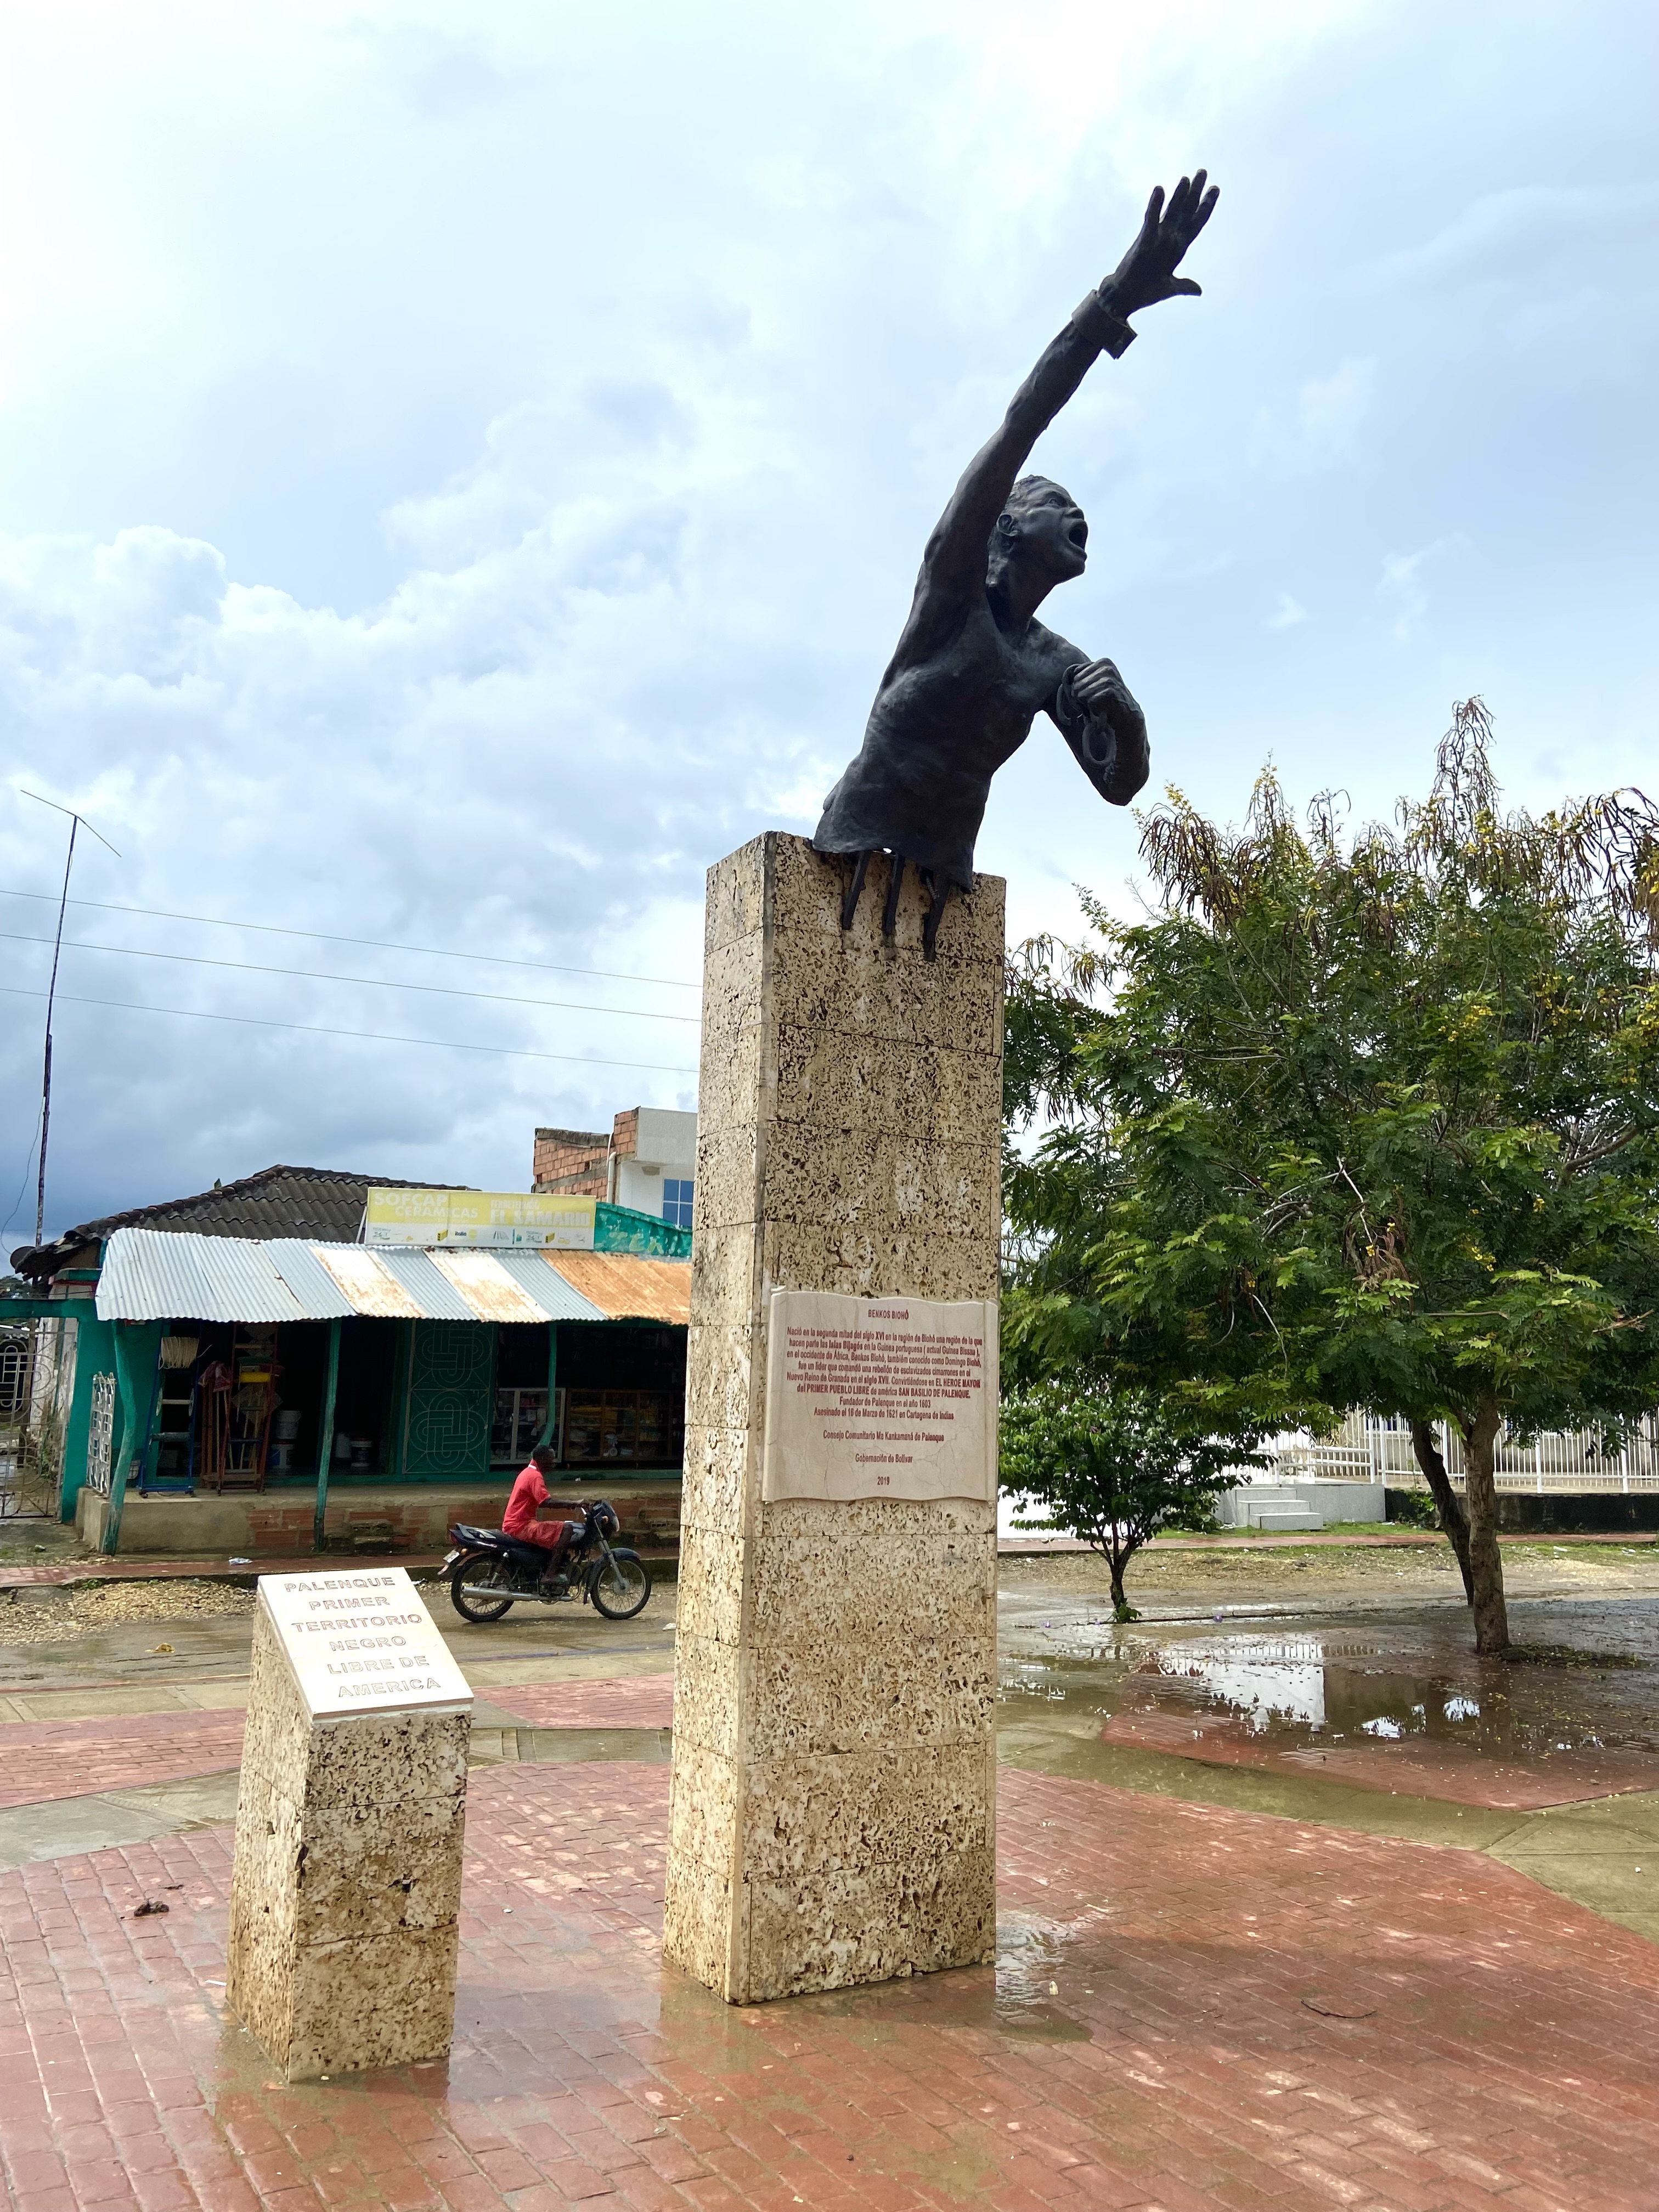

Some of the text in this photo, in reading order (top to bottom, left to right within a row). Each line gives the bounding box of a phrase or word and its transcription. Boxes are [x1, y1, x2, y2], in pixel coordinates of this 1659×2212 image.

[374, 1192, 448, 1206] SOFCAP
[395, 1206, 478, 1218] CERAMICAS
[490, 1209, 507, 1224] EL
[868, 1310, 909, 1320] BENKOS BIOHÓ
[787, 1327, 802, 1335] Nació
[811, 1328, 815, 1336] la
[816, 1329, 838, 1339] segunda
[839, 1330, 853, 1339] mitad
[863, 1331, 874, 1342] siglo
[876, 1331, 884, 1341] XVI
[898, 1334, 913, 1344] región
[915, 1334, 921, 1342] de
[922, 1334, 935, 1343] Biohó
[946, 1336, 961, 1346] región
[962, 1336, 968, 1345] de
[968, 1336, 973, 1345] la
[974, 1339, 983, 1347] que
[789, 1338, 805, 1347] hacen
[806, 1340, 819, 1349] parte
[829, 1340, 842, 1349] Islas
[843, 1341, 863, 1352] Bijagós
[872, 1342, 876, 1351] la
[877, 1343, 894, 1352] Guinea
[896, 1344, 922, 1355] portuguesa
[927, 1346, 941, 1354] actual
[943, 1346, 959, 1355] Guinea
[960, 1347, 975, 1356] Bissau
[794, 1350, 799, 1358] el
[800, 1351, 825, 1359] occidente
[826, 1351, 833, 1360] de
[834, 1350, 850, 1362] África,
[851, 1352, 870, 1362] Benkos
[909, 1356, 930, 1364] conocido
[945, 1357, 966, 1368] Domingo
[828, 1364, 837, 1373] que
[838, 1364, 861, 1372] comandó
[872, 1365, 892, 1374] rebelión
[893, 1365, 900, 1374] de
[901, 1366, 931, 1375] esclavizados
[966, 1369, 970, 1377] el
[787, 1372, 803, 1381] Nuevo
[805, 1373, 820, 1381] Reino
[821, 1373, 827, 1381] de
[828, 1373, 850, 1383] Granada
[858, 1375, 863, 1383] el
[864, 1375, 877, 1386] siglo
[891, 1376, 928, 1386] Convirtiéndose
[936, 1378, 943, 1387] EL
[944, 1378, 961, 1387] HEROE
[797, 1384, 970, 1399] del PRIMER PUEBLO LIBRE de américa SAN BASILIO DE PALENQUE.
[840, 1396, 864, 1406] Fundador
[865, 1397, 871, 1406] de
[872, 1398, 895, 1409] Palenque
[904, 1399, 908, 1407] el
[909, 1400, 918, 1408] año
[919, 1400, 930, 1408] 1603
[814, 1407, 840, 1417] Asesinado
[842, 1408, 847, 1417] el
[855, 1408, 861, 1417] de
[862, 1408, 878, 1418] Marzo
[879, 1409, 885, 1418] de
[887, 1409, 898, 1418] 1621
[906, 1410, 932, 1421] Cartagena
[933, 1411, 939, 1419] de
[823, 1430, 944, 1443] Consejo Comunitario Ma Kankamaná de Palenque
[856, 1454, 913, 1463] Gobernación de Bolívar
[878, 1476, 890, 1485] 2019
[285, 1577, 396, 1593] PALENQUE
[309, 1596, 391, 1611] PRIMER
[291, 1613, 422, 1633] TERRITORIO
[329, 1635, 407, 1651] NEGRO
[328, 1655, 430, 1674] LIBRE DE
[338, 1678, 441, 1697] AMERICA
